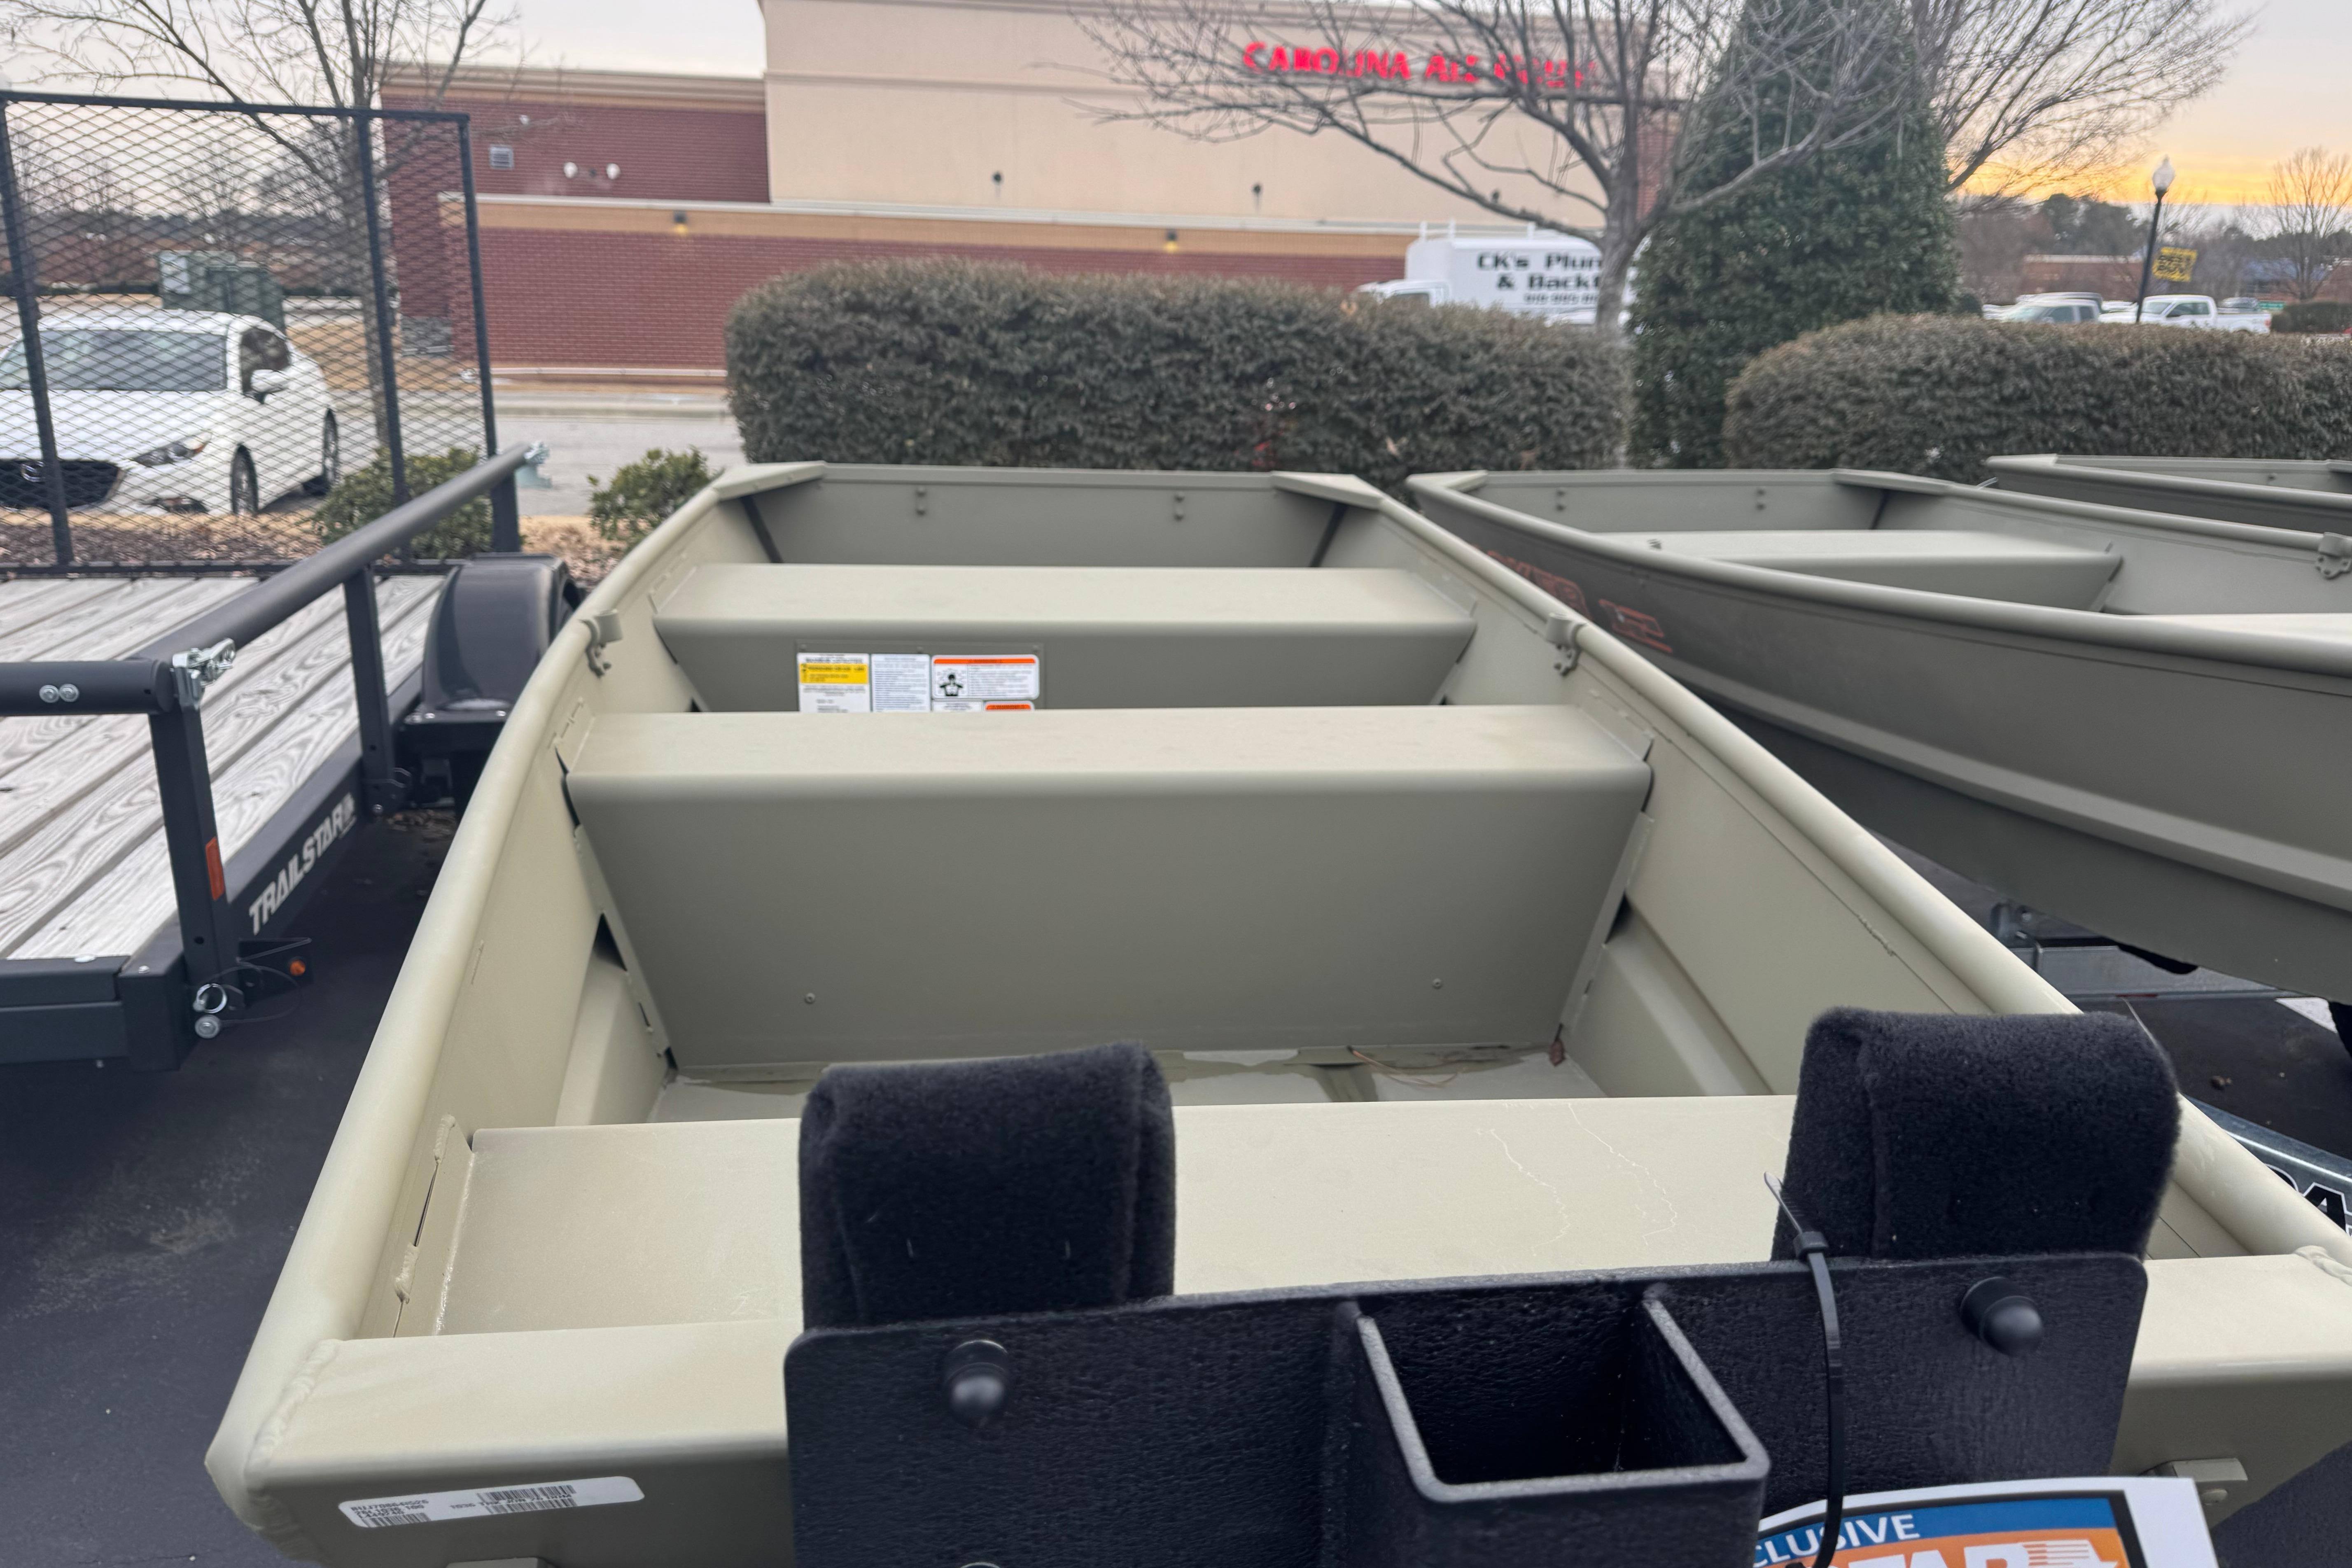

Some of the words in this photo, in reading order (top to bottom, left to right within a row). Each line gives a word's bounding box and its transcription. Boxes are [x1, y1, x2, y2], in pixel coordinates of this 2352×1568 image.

[1243, 42, 1411, 80] CAROLINA
[1478, 252, 1528, 268] CK's
[1497, 274, 1514, 289] &
[249, 802, 343, 936] TRAILSTAR
